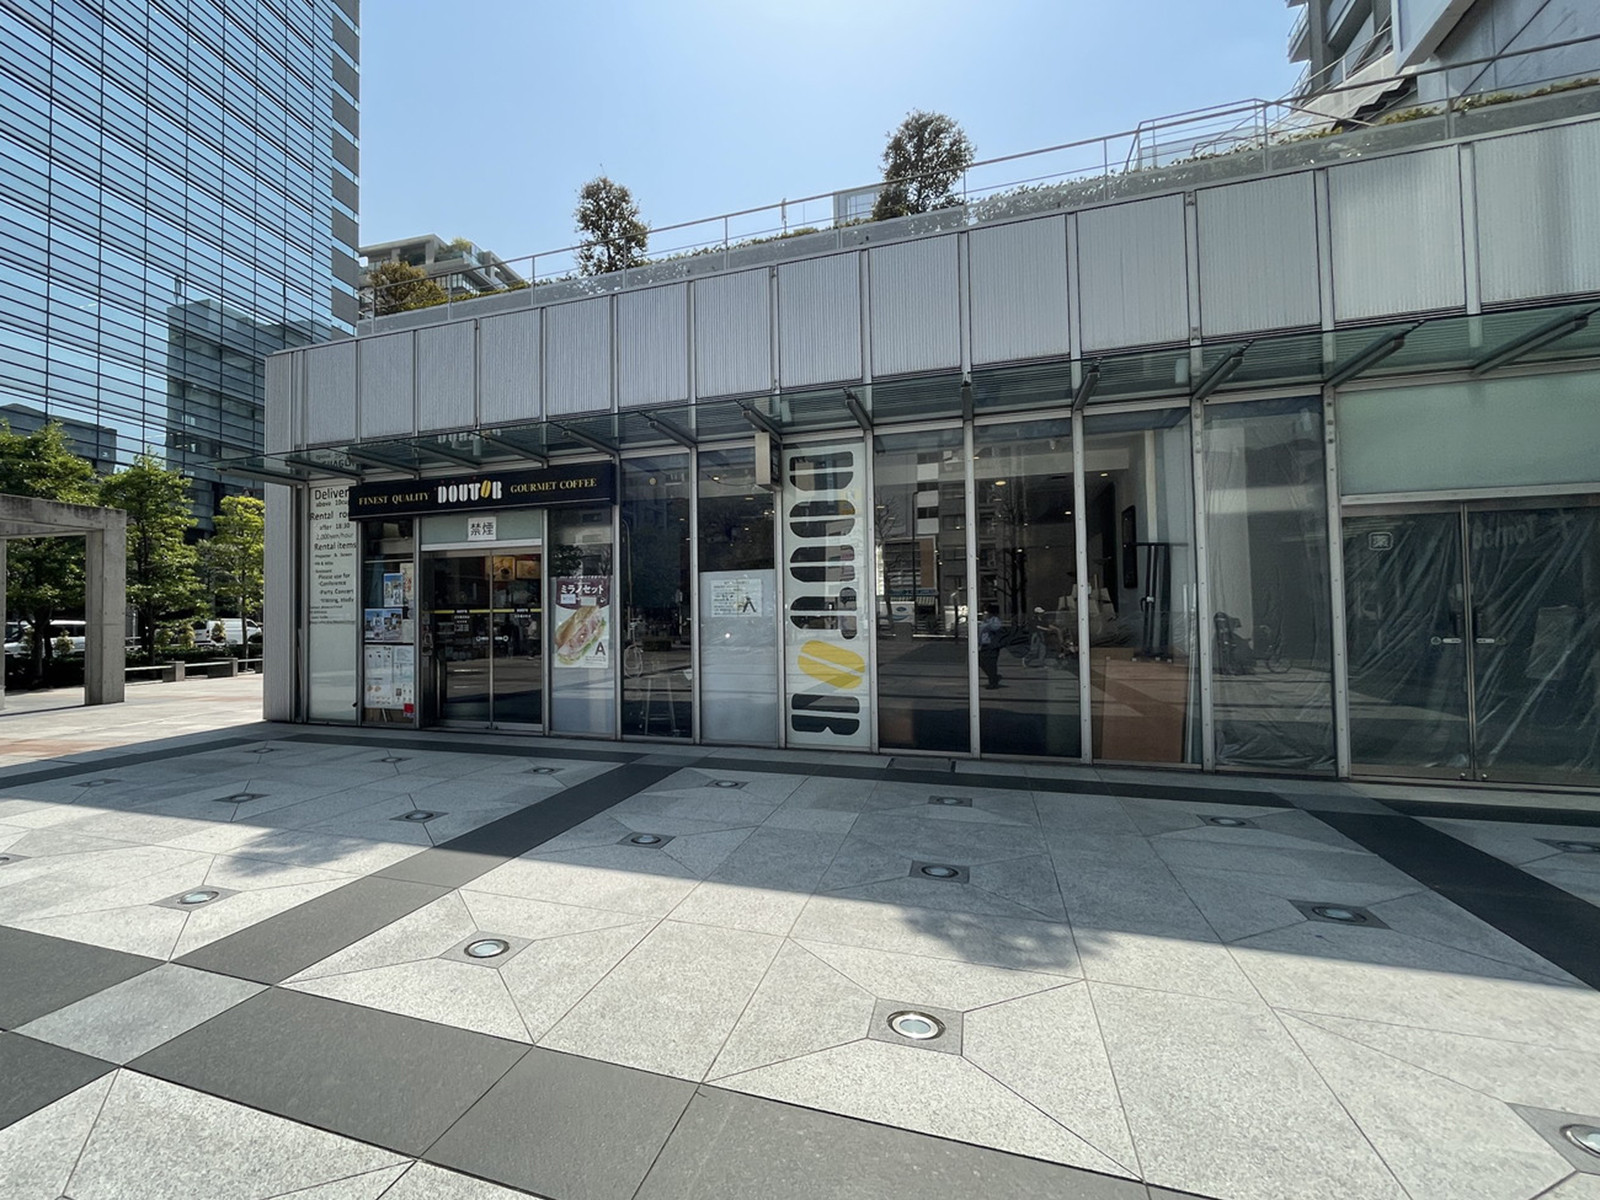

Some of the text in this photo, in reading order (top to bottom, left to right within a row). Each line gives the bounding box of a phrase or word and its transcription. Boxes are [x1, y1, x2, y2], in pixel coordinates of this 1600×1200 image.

[358, 478, 597, 505] FINEST QUALITY DOUTOR GOURMET COFFEE
[470, 521, 494, 536] 禁煙
[314, 541, 336, 551] Rental
[561, 584, 604, 595] ミラノセット
[789, 451, 866, 736] DOUTOR
